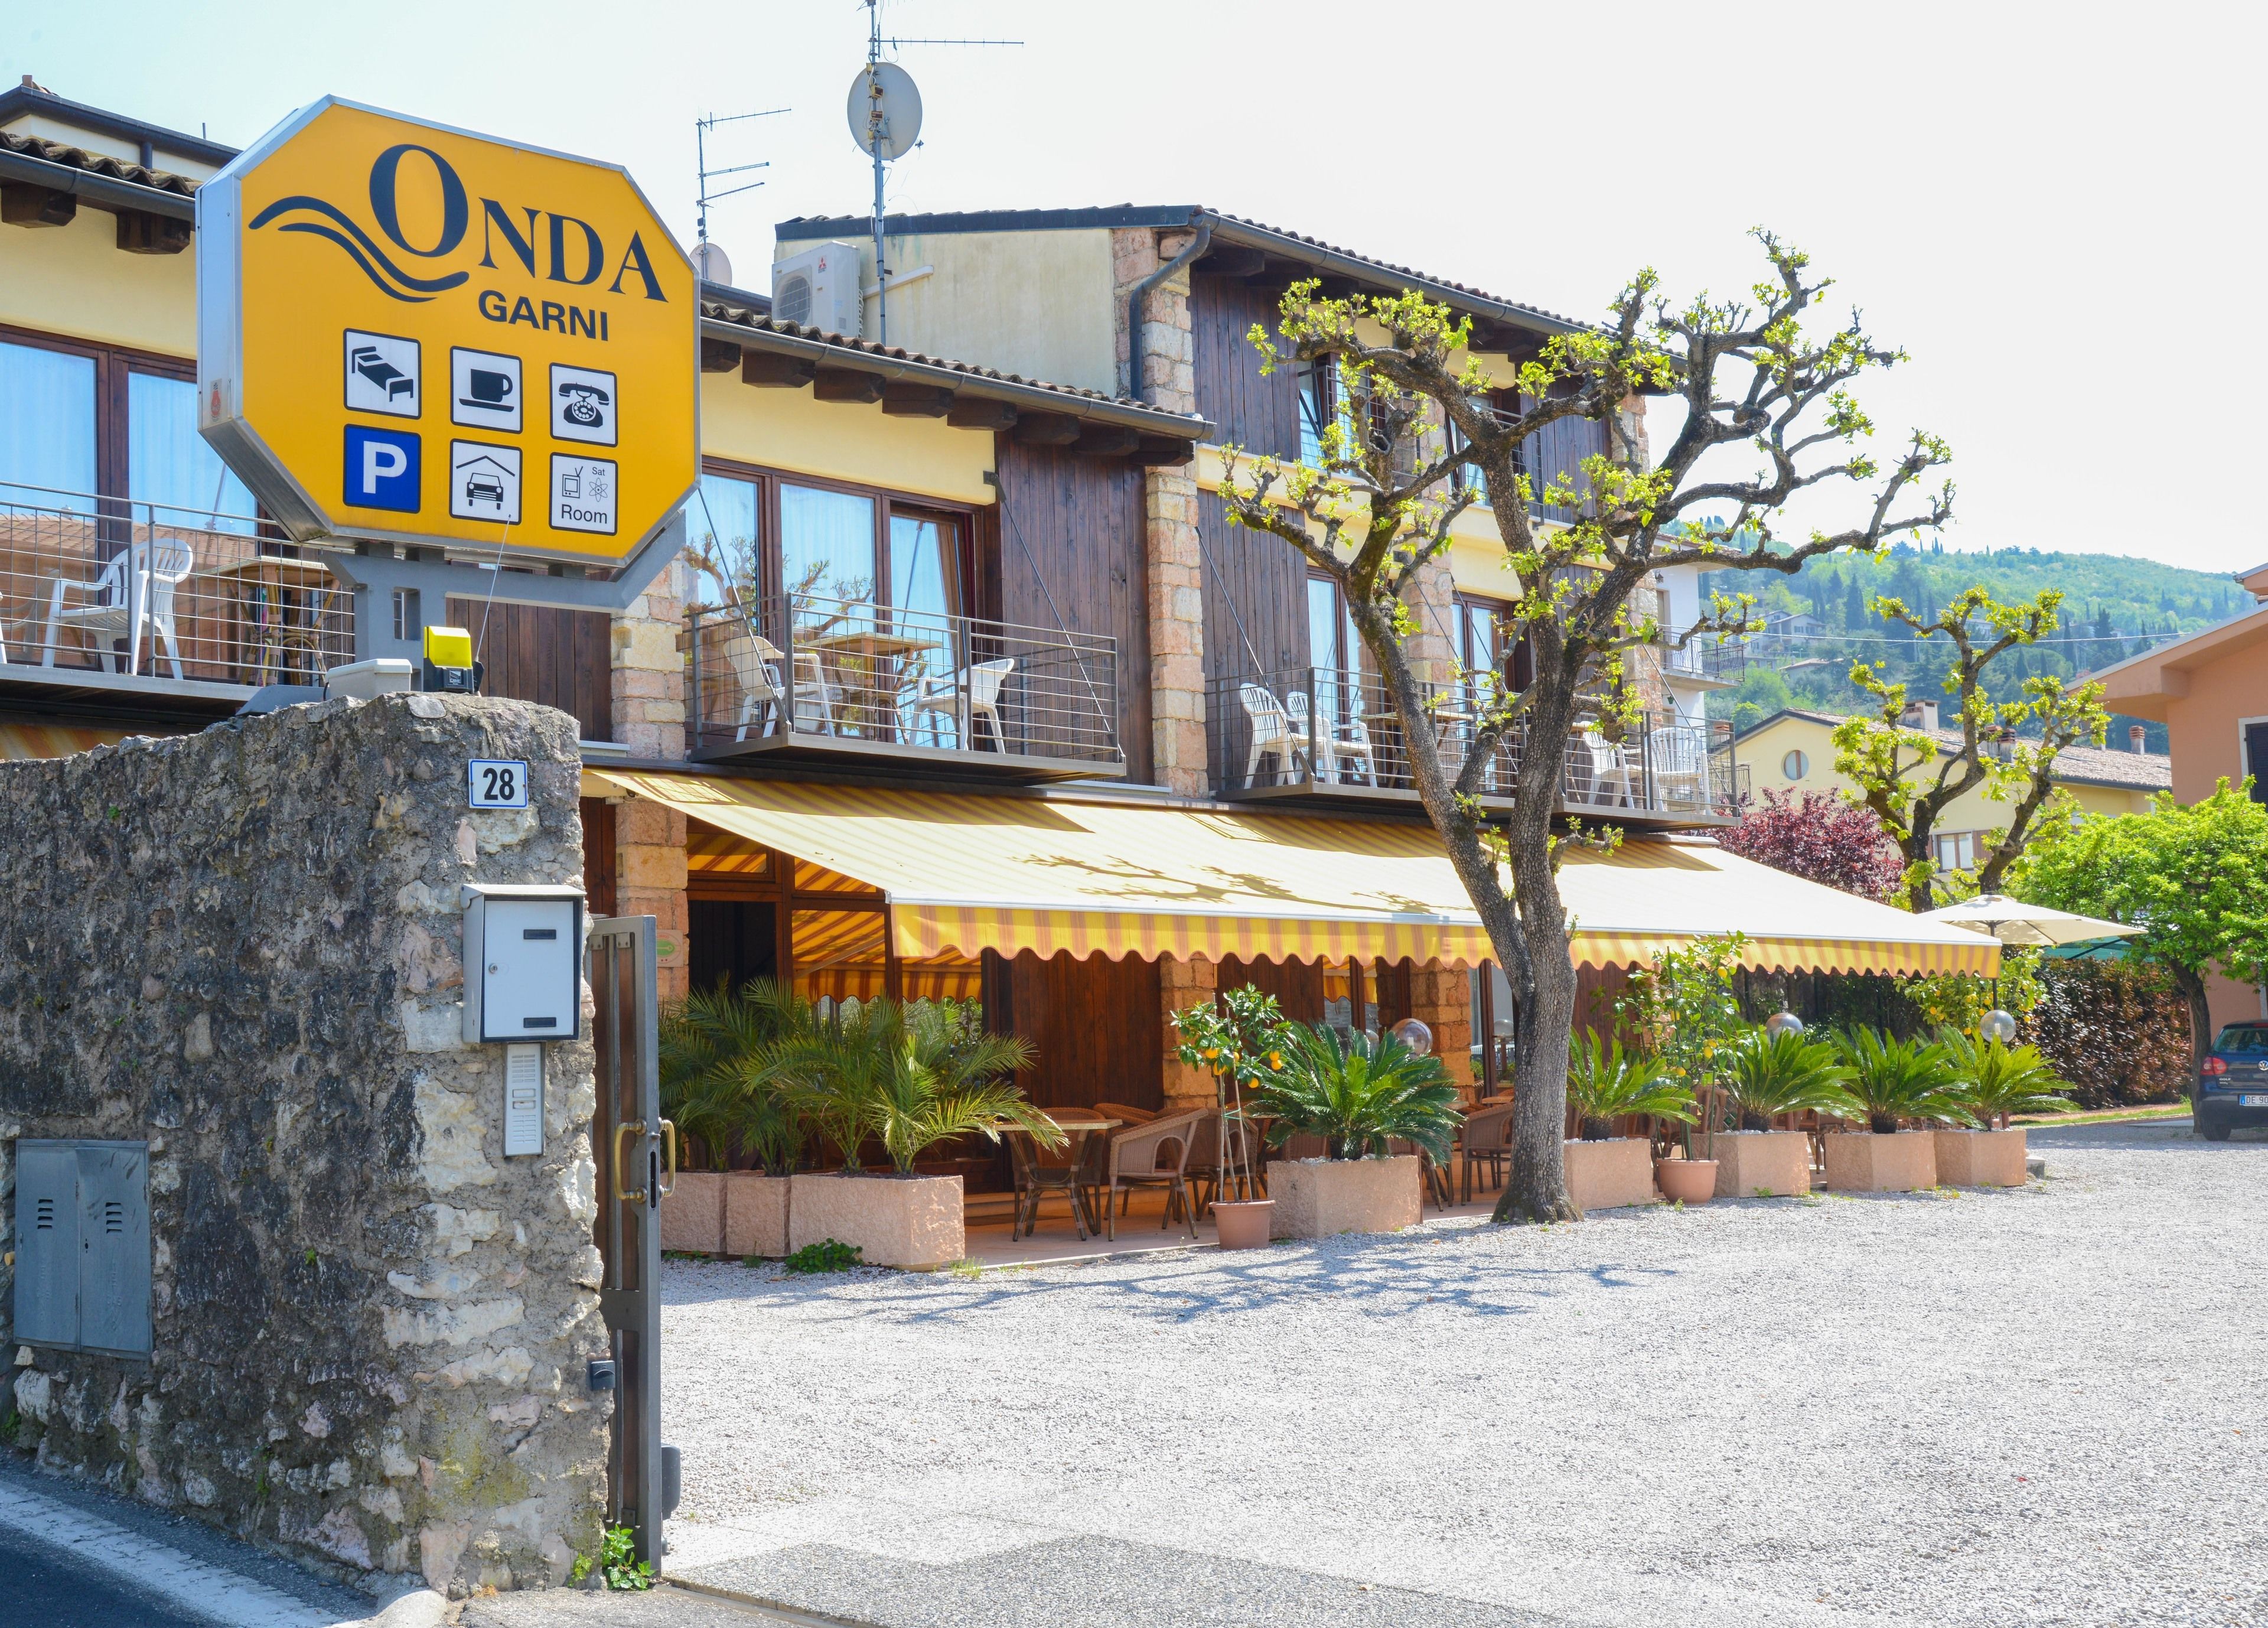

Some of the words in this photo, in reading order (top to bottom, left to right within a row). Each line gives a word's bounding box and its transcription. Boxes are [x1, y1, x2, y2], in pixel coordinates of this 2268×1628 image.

[369, 144, 669, 303] ONDA
[478, 289, 608, 341] GARNI
[363, 441, 407, 494] P
[592, 467, 605, 476] Sat
[561, 504, 607, 524] Room
[483, 767, 515, 800] 28
